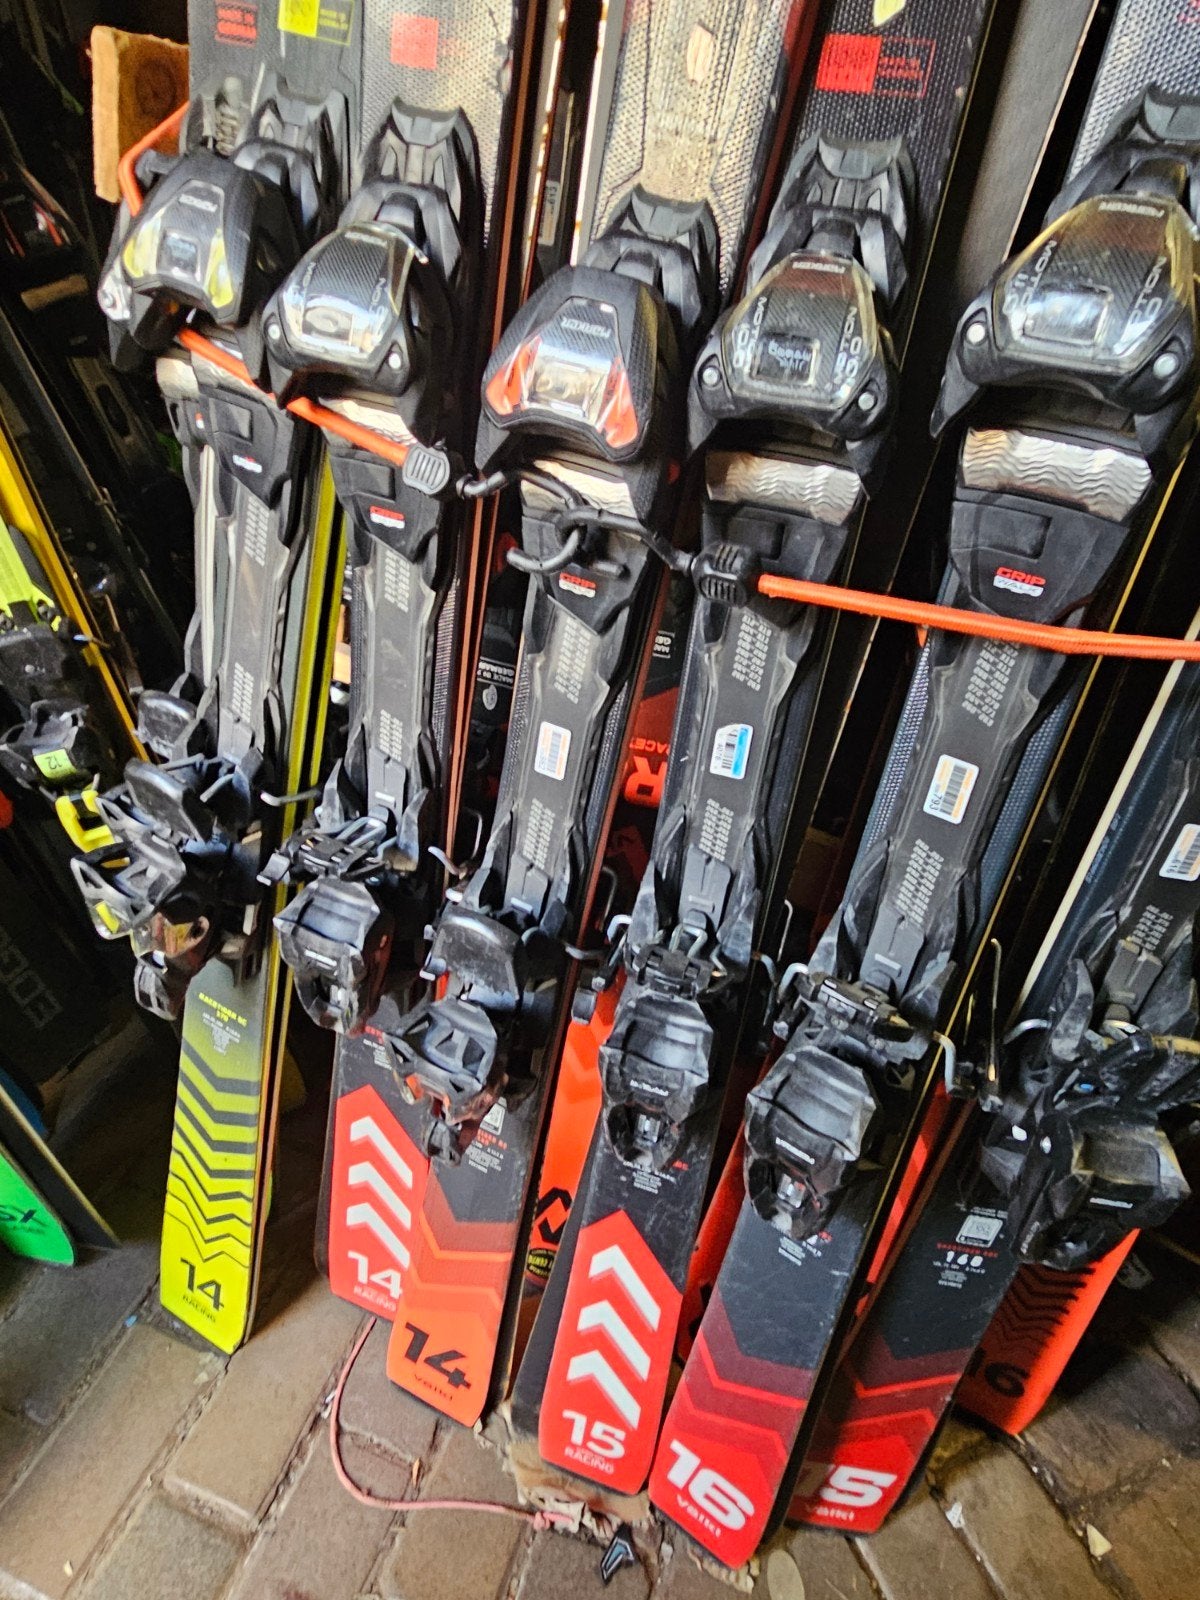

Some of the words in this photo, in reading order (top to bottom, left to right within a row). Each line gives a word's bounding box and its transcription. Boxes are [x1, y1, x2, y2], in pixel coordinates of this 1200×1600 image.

[997, 567, 1046, 586] GRIP
[180, 1257, 225, 1312] 14
[347, 1250, 403, 1299] 14
[353, 1286, 397, 1312] RACING
[404, 1321, 472, 1389] 14
[562, 1409, 626, 1459] 15
[564, 1446, 614, 1475] RACING
[667, 1438, 755, 1530] 16
